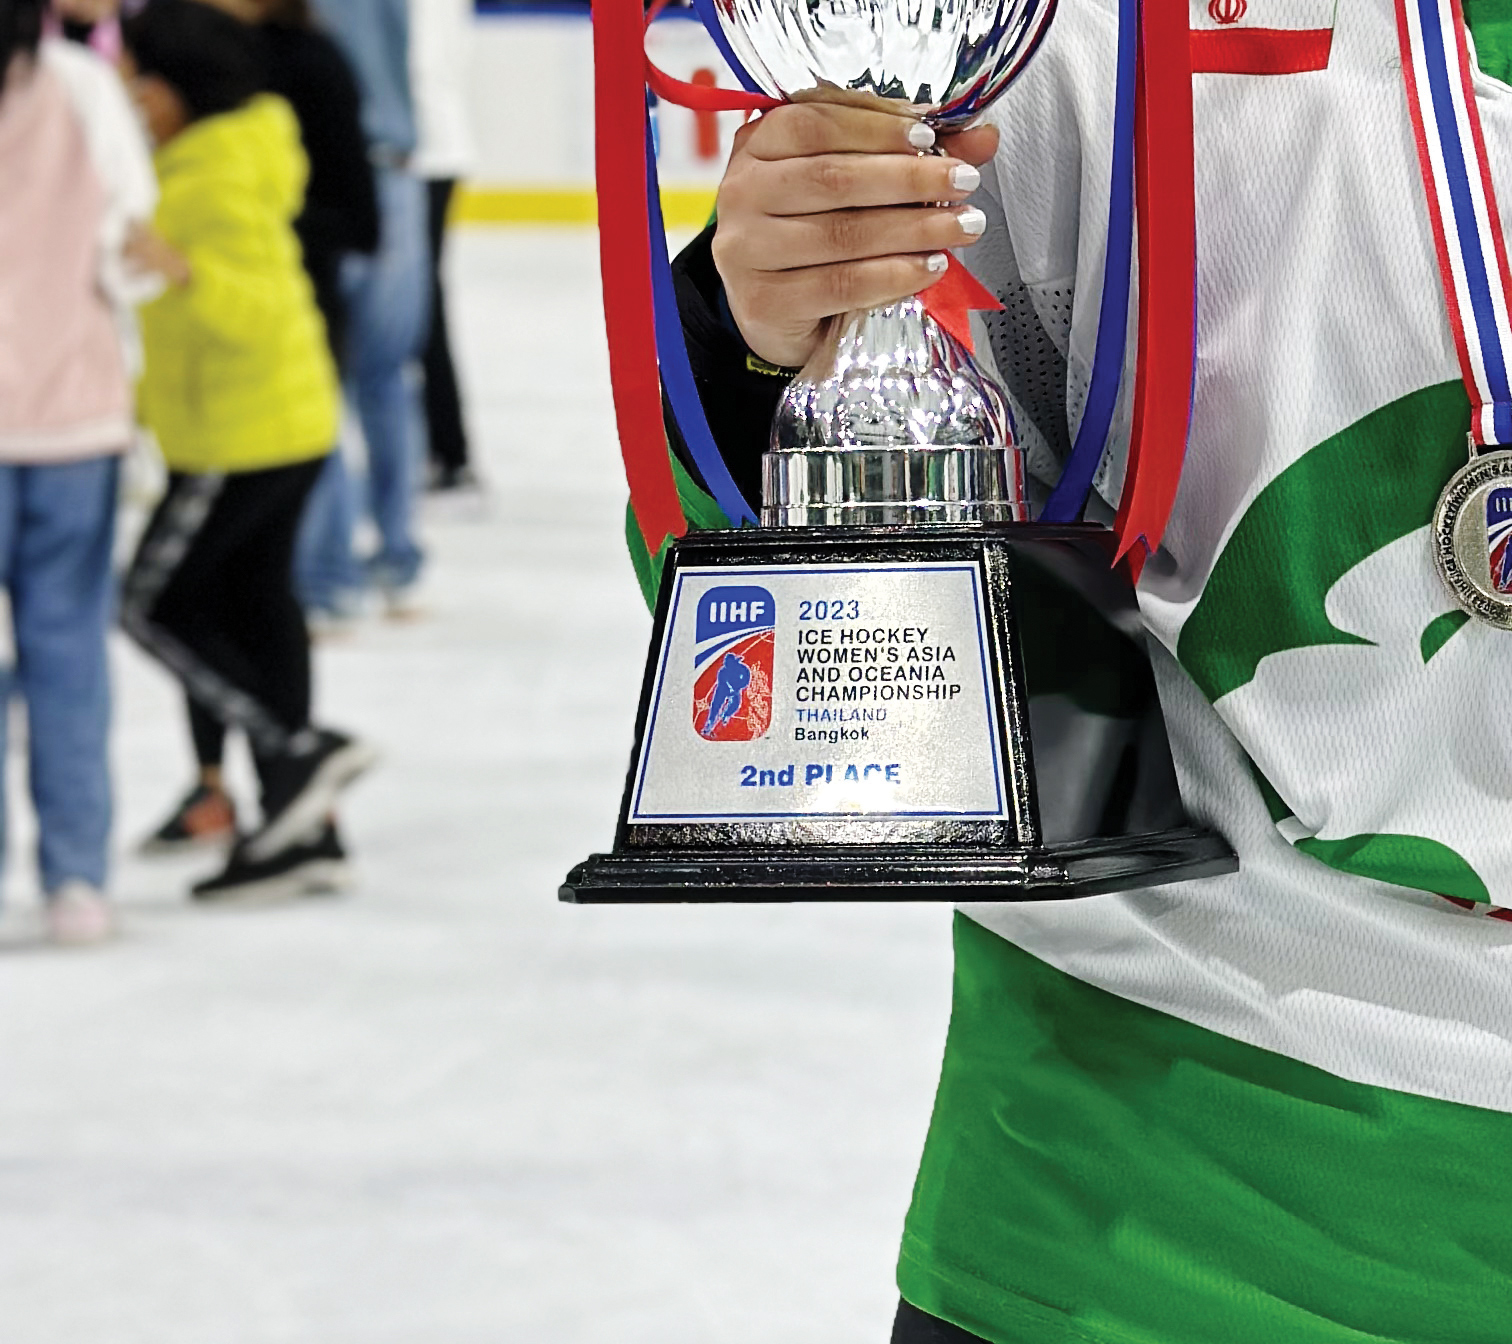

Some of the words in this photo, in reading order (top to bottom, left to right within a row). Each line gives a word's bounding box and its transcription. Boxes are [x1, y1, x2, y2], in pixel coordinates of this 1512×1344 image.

[709, 601, 765, 623] IIHF
[798, 599, 861, 621] 2023
[797, 629, 833, 645] ICE
[840, 628, 929, 645] HOCKEY
[796, 646, 899, 665] WOMEN'S
[906, 646, 956, 662] ASIA
[796, 666, 841, 684] AND
[848, 665, 946, 682] OCEANIA
[796, 683, 962, 702] CHAMPIONSHIP
[796, 708, 887, 723] THAILAND
[794, 727, 870, 744] Bangkok
[740, 764, 795, 788] 2nd
